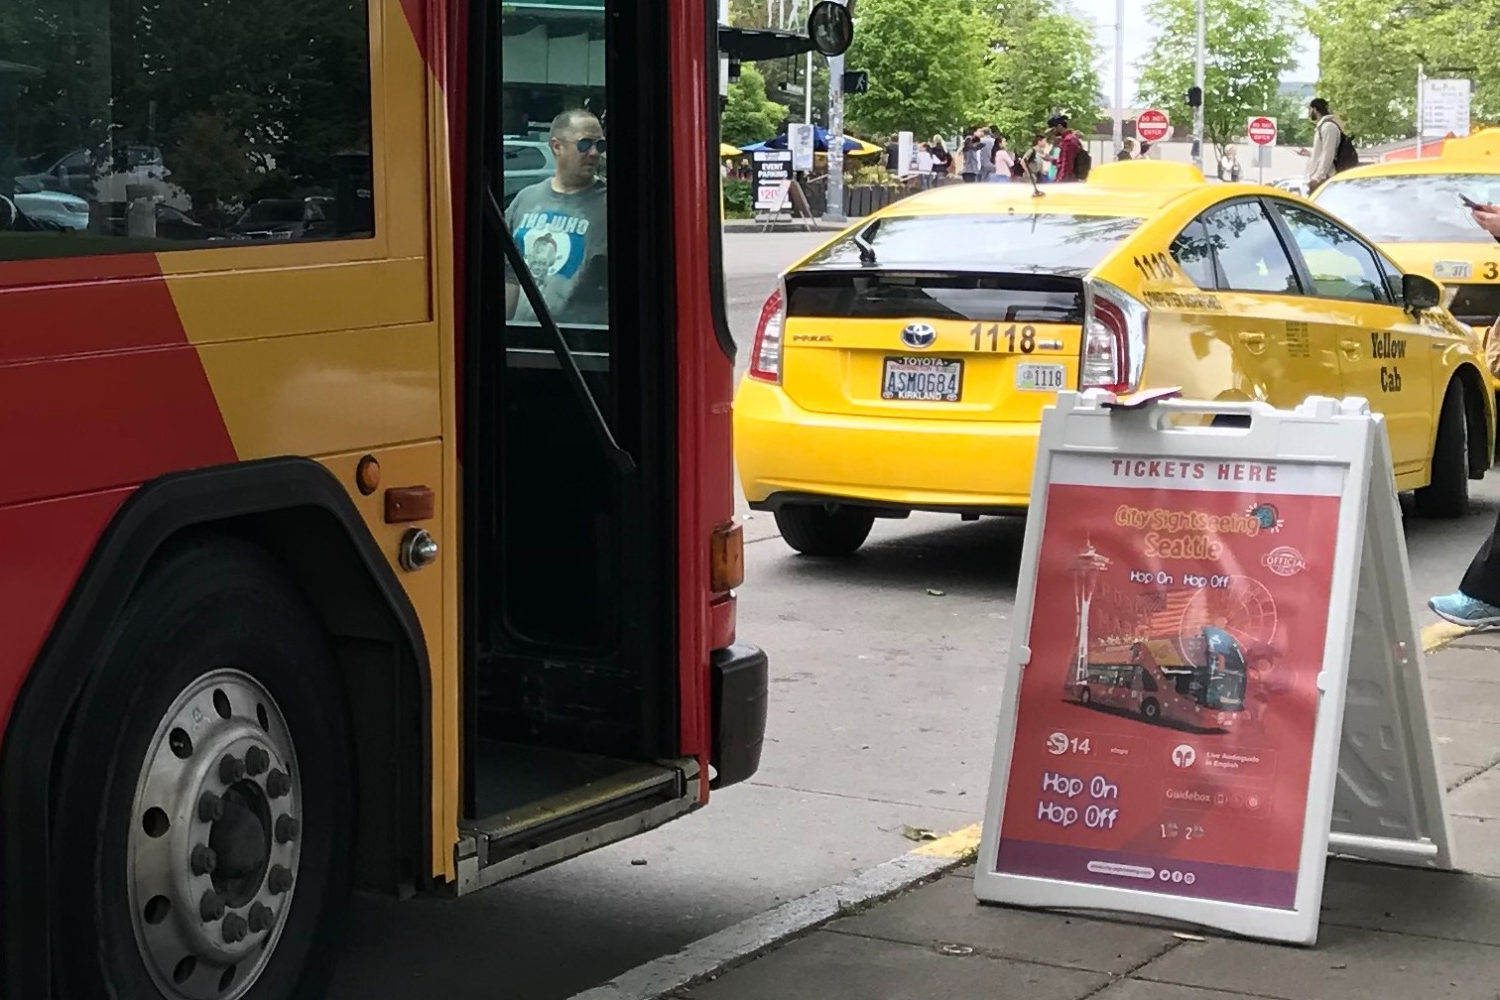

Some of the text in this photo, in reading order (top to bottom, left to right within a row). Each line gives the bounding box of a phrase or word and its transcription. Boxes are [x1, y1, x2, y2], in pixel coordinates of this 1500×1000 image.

[757, 170, 789, 179] PARKING
[761, 162, 784, 171] EVENT
[1133, 251, 1174, 281] 1118
[1451, 264, 1468, 278] 371
[1482, 261, 1499, 280] 3
[969, 322, 1037, 354] 1118
[1371, 332, 1407, 359] Yellow
[902, 356, 944, 366] TOYOTA
[1034, 369, 1062, 387] 1118
[1380, 366, 1402, 392] Cab
[898, 390, 942, 401] KIRKLAND
[1111, 459, 1278, 483] TICKETS HERE
[1115, 504, 1260, 538] City Sightseeing
[1144, 531, 1224, 562] Seattle
[1266, 555, 1307, 571] OFFICIAL
[1130, 569, 1230, 589] Hop On Hop Off
[1070, 737, 1091, 755] 14
[1042, 772, 1118, 799] Hop On
[1165, 788, 1211, 802] Guidebox
[1037, 800, 1120, 829] Hop Off
